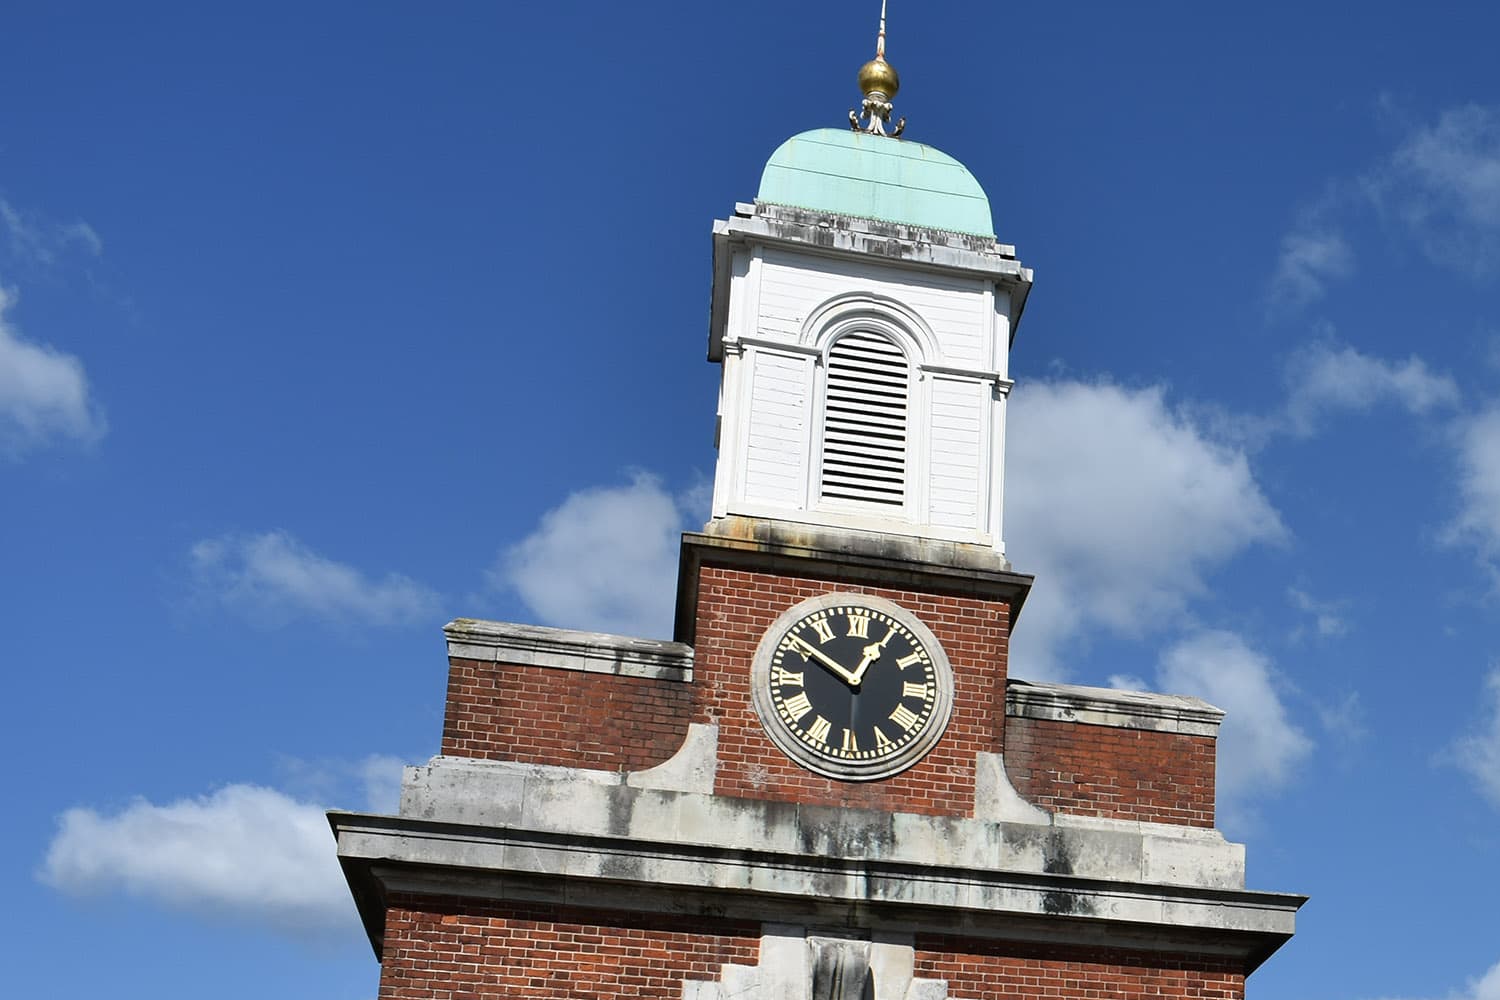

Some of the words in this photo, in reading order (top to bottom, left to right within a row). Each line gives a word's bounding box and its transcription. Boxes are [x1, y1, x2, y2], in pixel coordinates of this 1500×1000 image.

[810, 618, 836, 644] XI
[847, 614, 870, 639] XII
[896, 651, 922, 671] II
[778, 668, 804, 687] IX
[902, 681, 928, 700] III
[783, 691, 813, 723] VIII
[888, 702, 919, 731] IIII
[806, 714, 832, 744] VII
[873, 726, 893, 749] V
